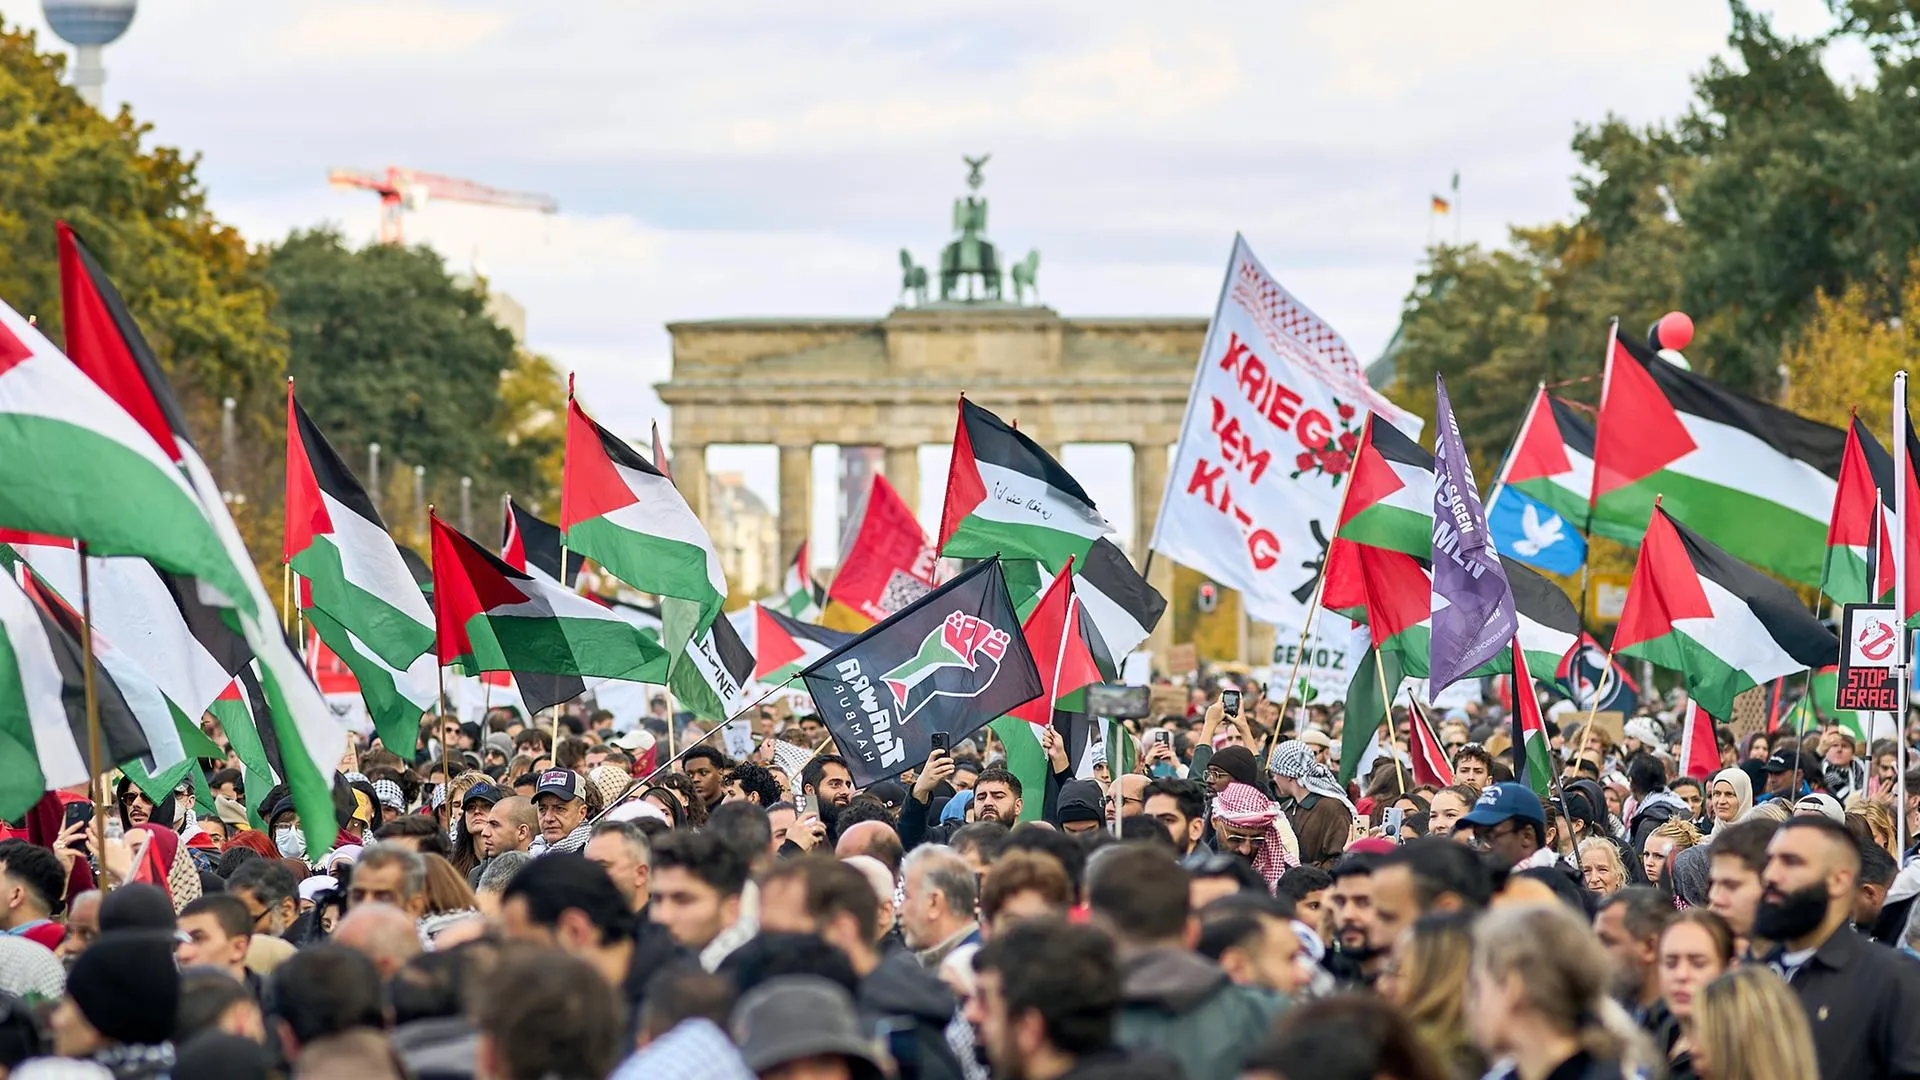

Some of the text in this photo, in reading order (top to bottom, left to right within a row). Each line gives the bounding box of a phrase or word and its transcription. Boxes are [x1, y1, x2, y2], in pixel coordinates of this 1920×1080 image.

[1218, 332, 1332, 450] KRIEG
[1450, 484, 1474, 534] SAGEN
[1848, 668, 1888, 688] STOP
[1839, 688, 1898, 709] ISRAEL
